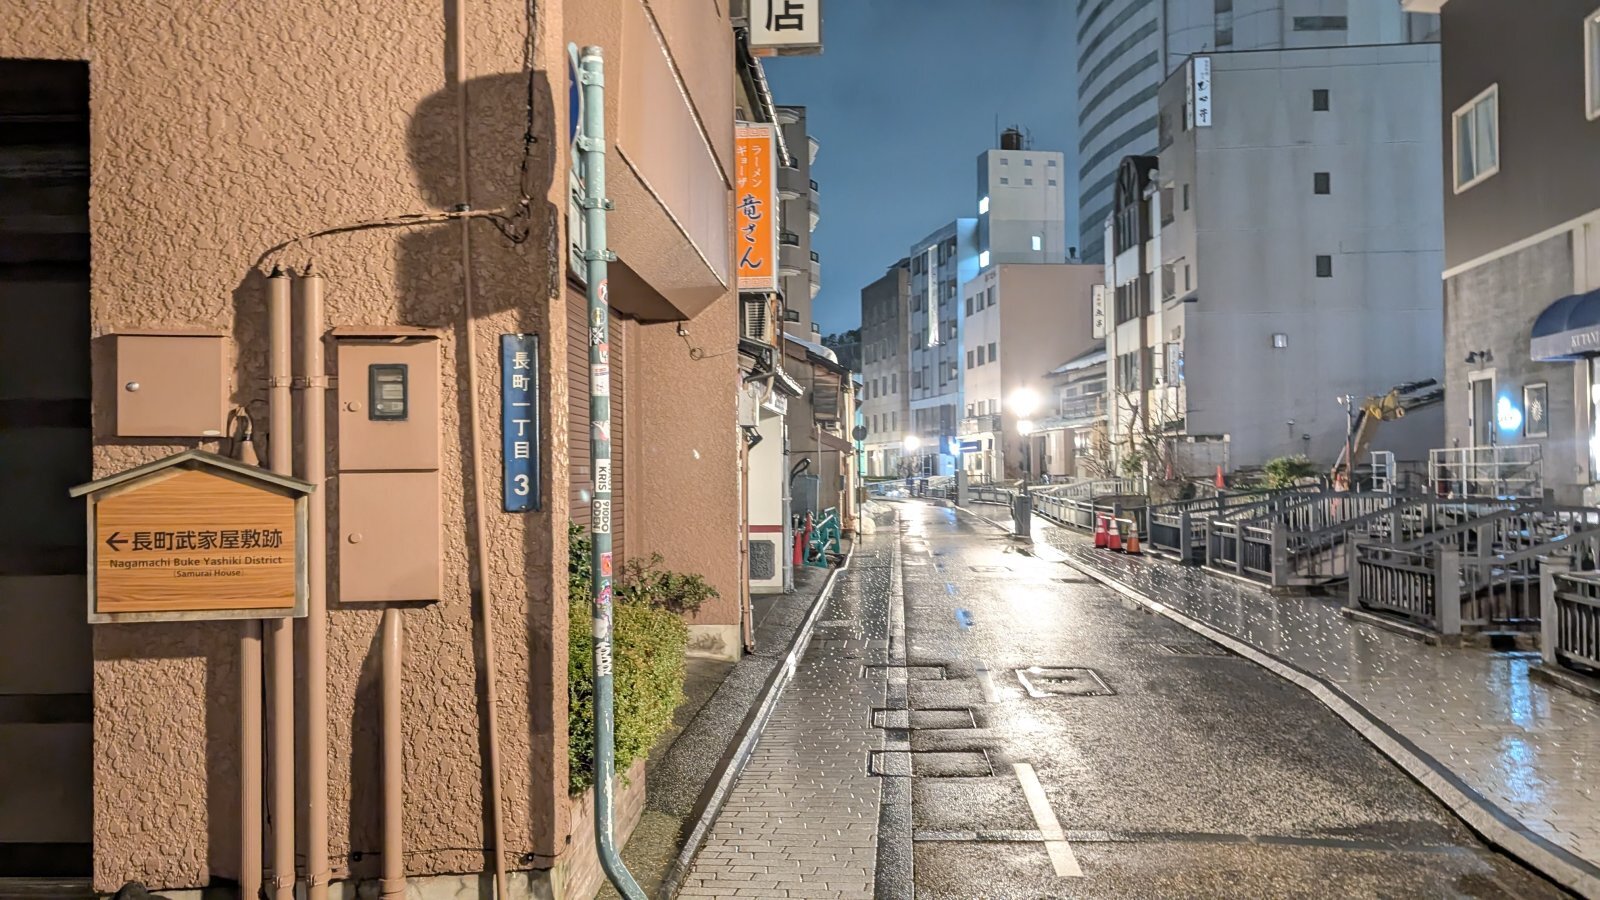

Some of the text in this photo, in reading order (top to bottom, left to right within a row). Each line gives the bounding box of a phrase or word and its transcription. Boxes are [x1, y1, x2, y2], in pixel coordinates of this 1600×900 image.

[737, 145, 748, 189] ギョーザ
[751, 145, 763, 188] ラーメン
[737, 194, 763, 269] 竜さん
[598, 466, 607, 491] KRIS
[132, 528, 283, 551] 長町武家屋敷跡
[110, 555, 283, 569] Nagamachi Buke Yashiki District
